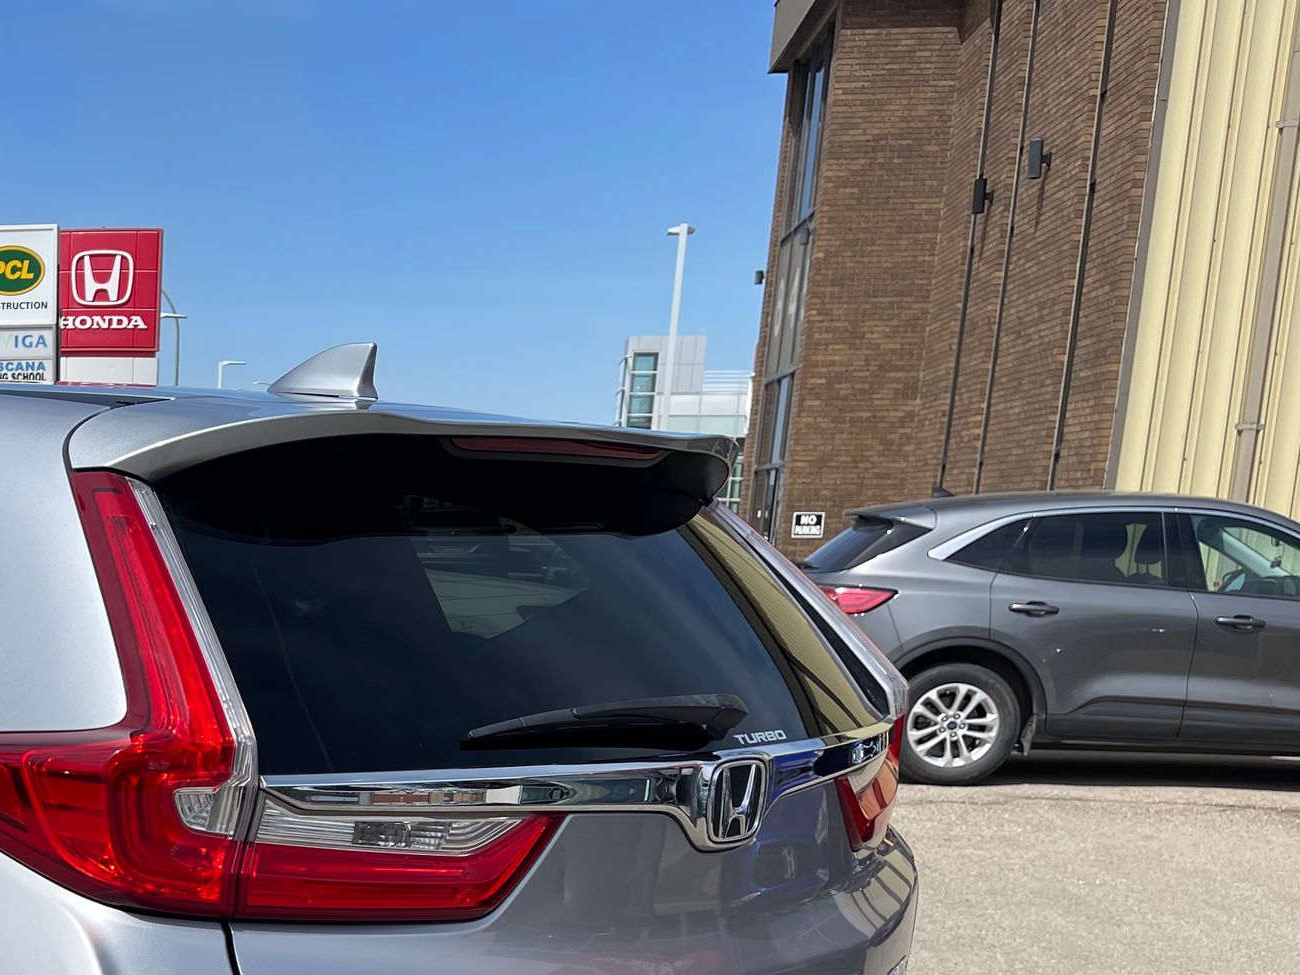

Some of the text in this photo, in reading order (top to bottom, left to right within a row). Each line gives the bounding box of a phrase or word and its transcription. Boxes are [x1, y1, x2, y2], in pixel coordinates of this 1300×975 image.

[59, 315, 148, 330] HONDA
[11, 373, 46, 381] SCHOOL
[800, 514, 817, 525] NO
[732, 729, 787, 745] TURBO
